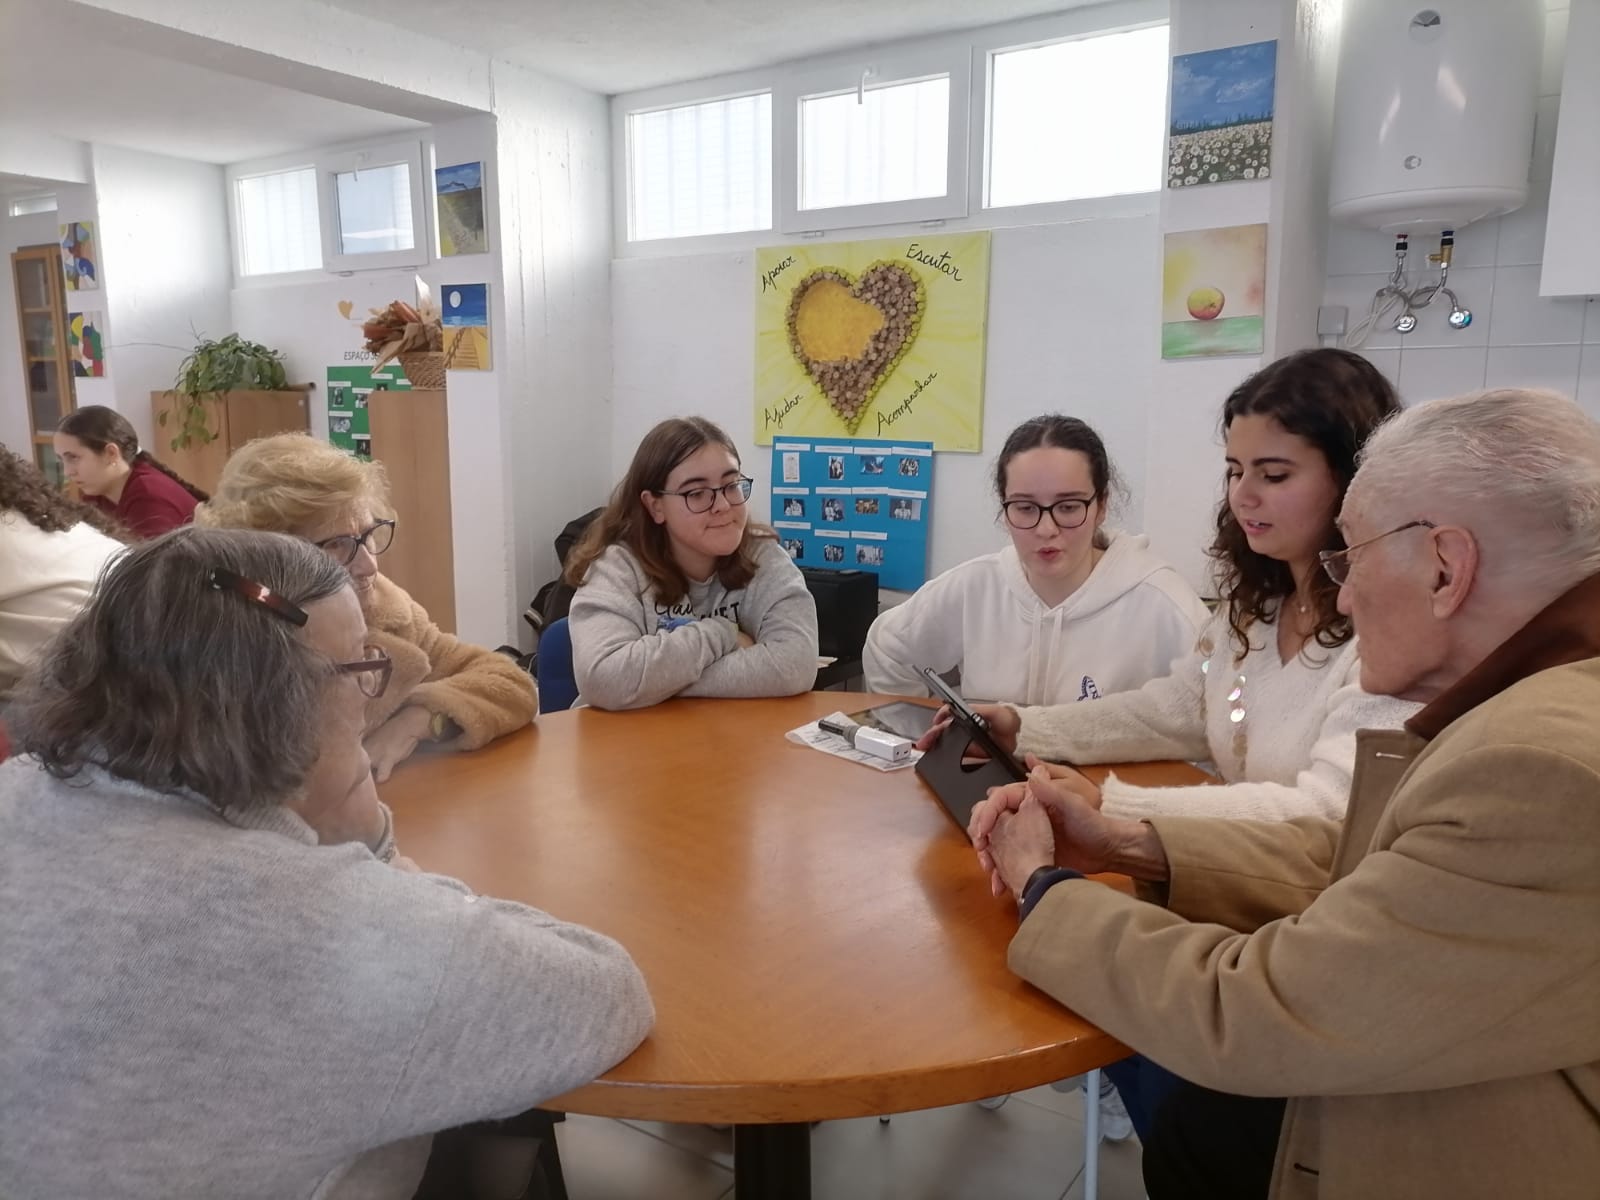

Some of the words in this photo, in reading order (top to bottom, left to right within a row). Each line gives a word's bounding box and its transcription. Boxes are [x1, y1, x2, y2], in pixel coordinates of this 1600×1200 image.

[762, 255, 797, 294] Apoiar
[906, 243, 963, 281] Escutar
[344, 351, 370, 362] ESPAÇO
[764, 394, 804, 431] Ajudar
[877, 371, 938, 437] Acompanhar
